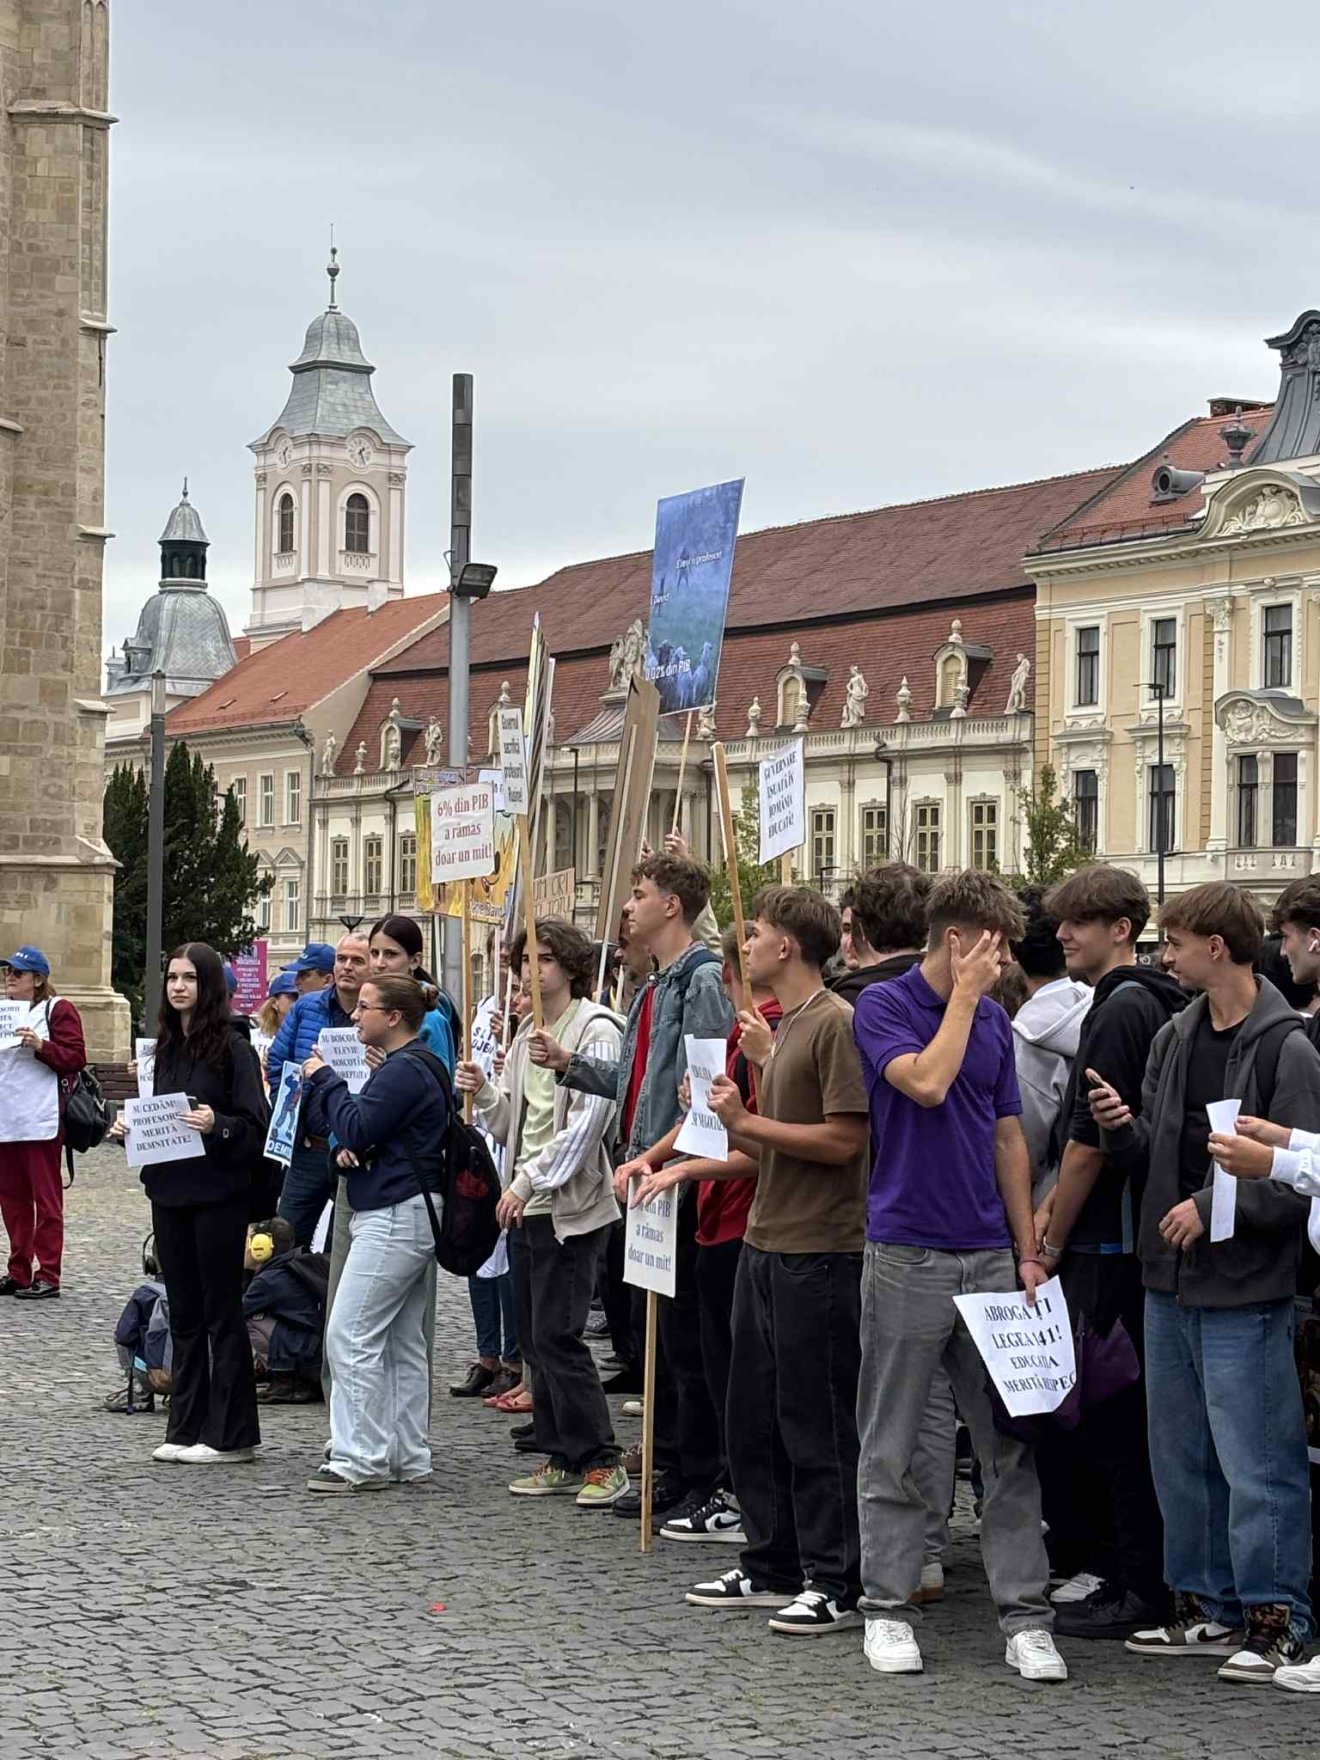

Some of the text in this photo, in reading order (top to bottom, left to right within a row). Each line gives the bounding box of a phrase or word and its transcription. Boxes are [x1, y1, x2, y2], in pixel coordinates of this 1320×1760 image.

[679, 659, 691, 674] PIB
[438, 793, 489, 817] 6% din PIB
[445, 828, 450, 840] a
[435, 842, 492, 867] doar un mit!
[136, 1135, 193, 1152] DEMNITATE!
[657, 1199, 671, 1218] PIB
[635, 1224, 640, 1237] a
[628, 1243, 672, 1272] doar un mit!
[992, 1331, 1034, 1350] LEGEA
